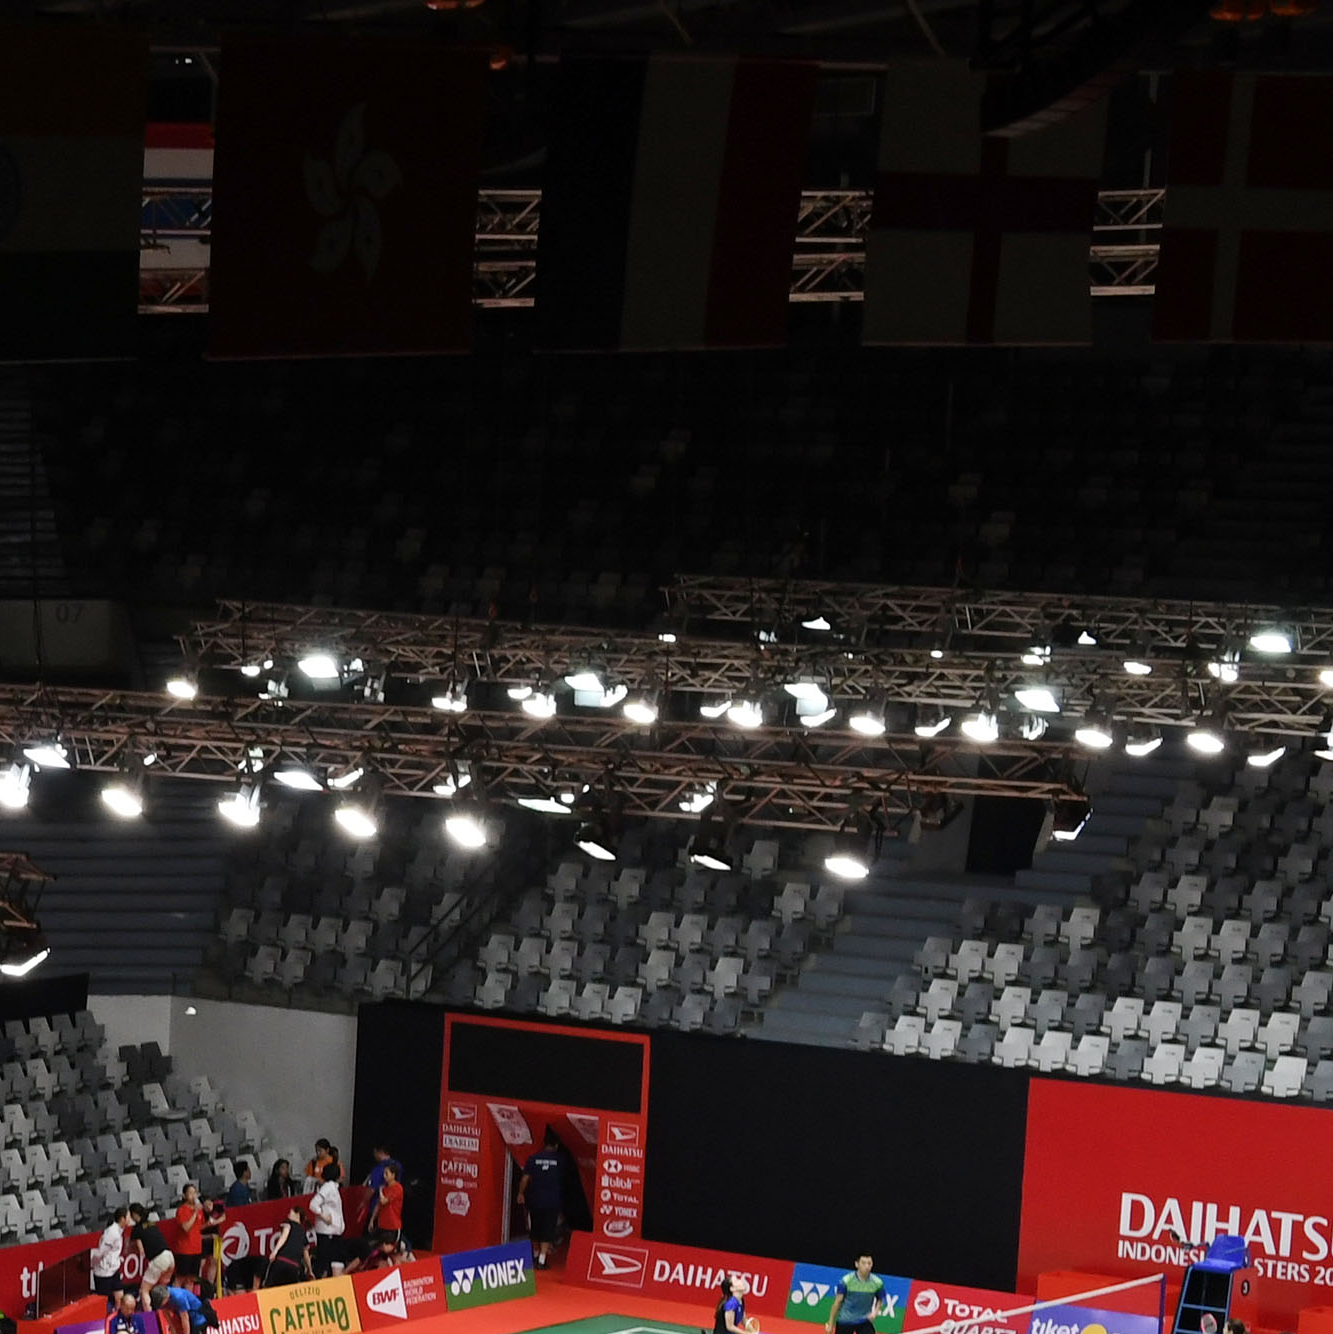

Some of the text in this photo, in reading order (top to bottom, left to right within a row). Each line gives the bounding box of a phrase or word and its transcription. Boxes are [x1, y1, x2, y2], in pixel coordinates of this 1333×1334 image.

[601, 1144, 643, 1158] DAIHATSU
[1119, 1191, 1333, 1262] DAIHATS
[478, 1258, 527, 1290] YONEX
[372, 1287, 400, 1306] BWF
[943, 1298, 1008, 1324] TOTAL
